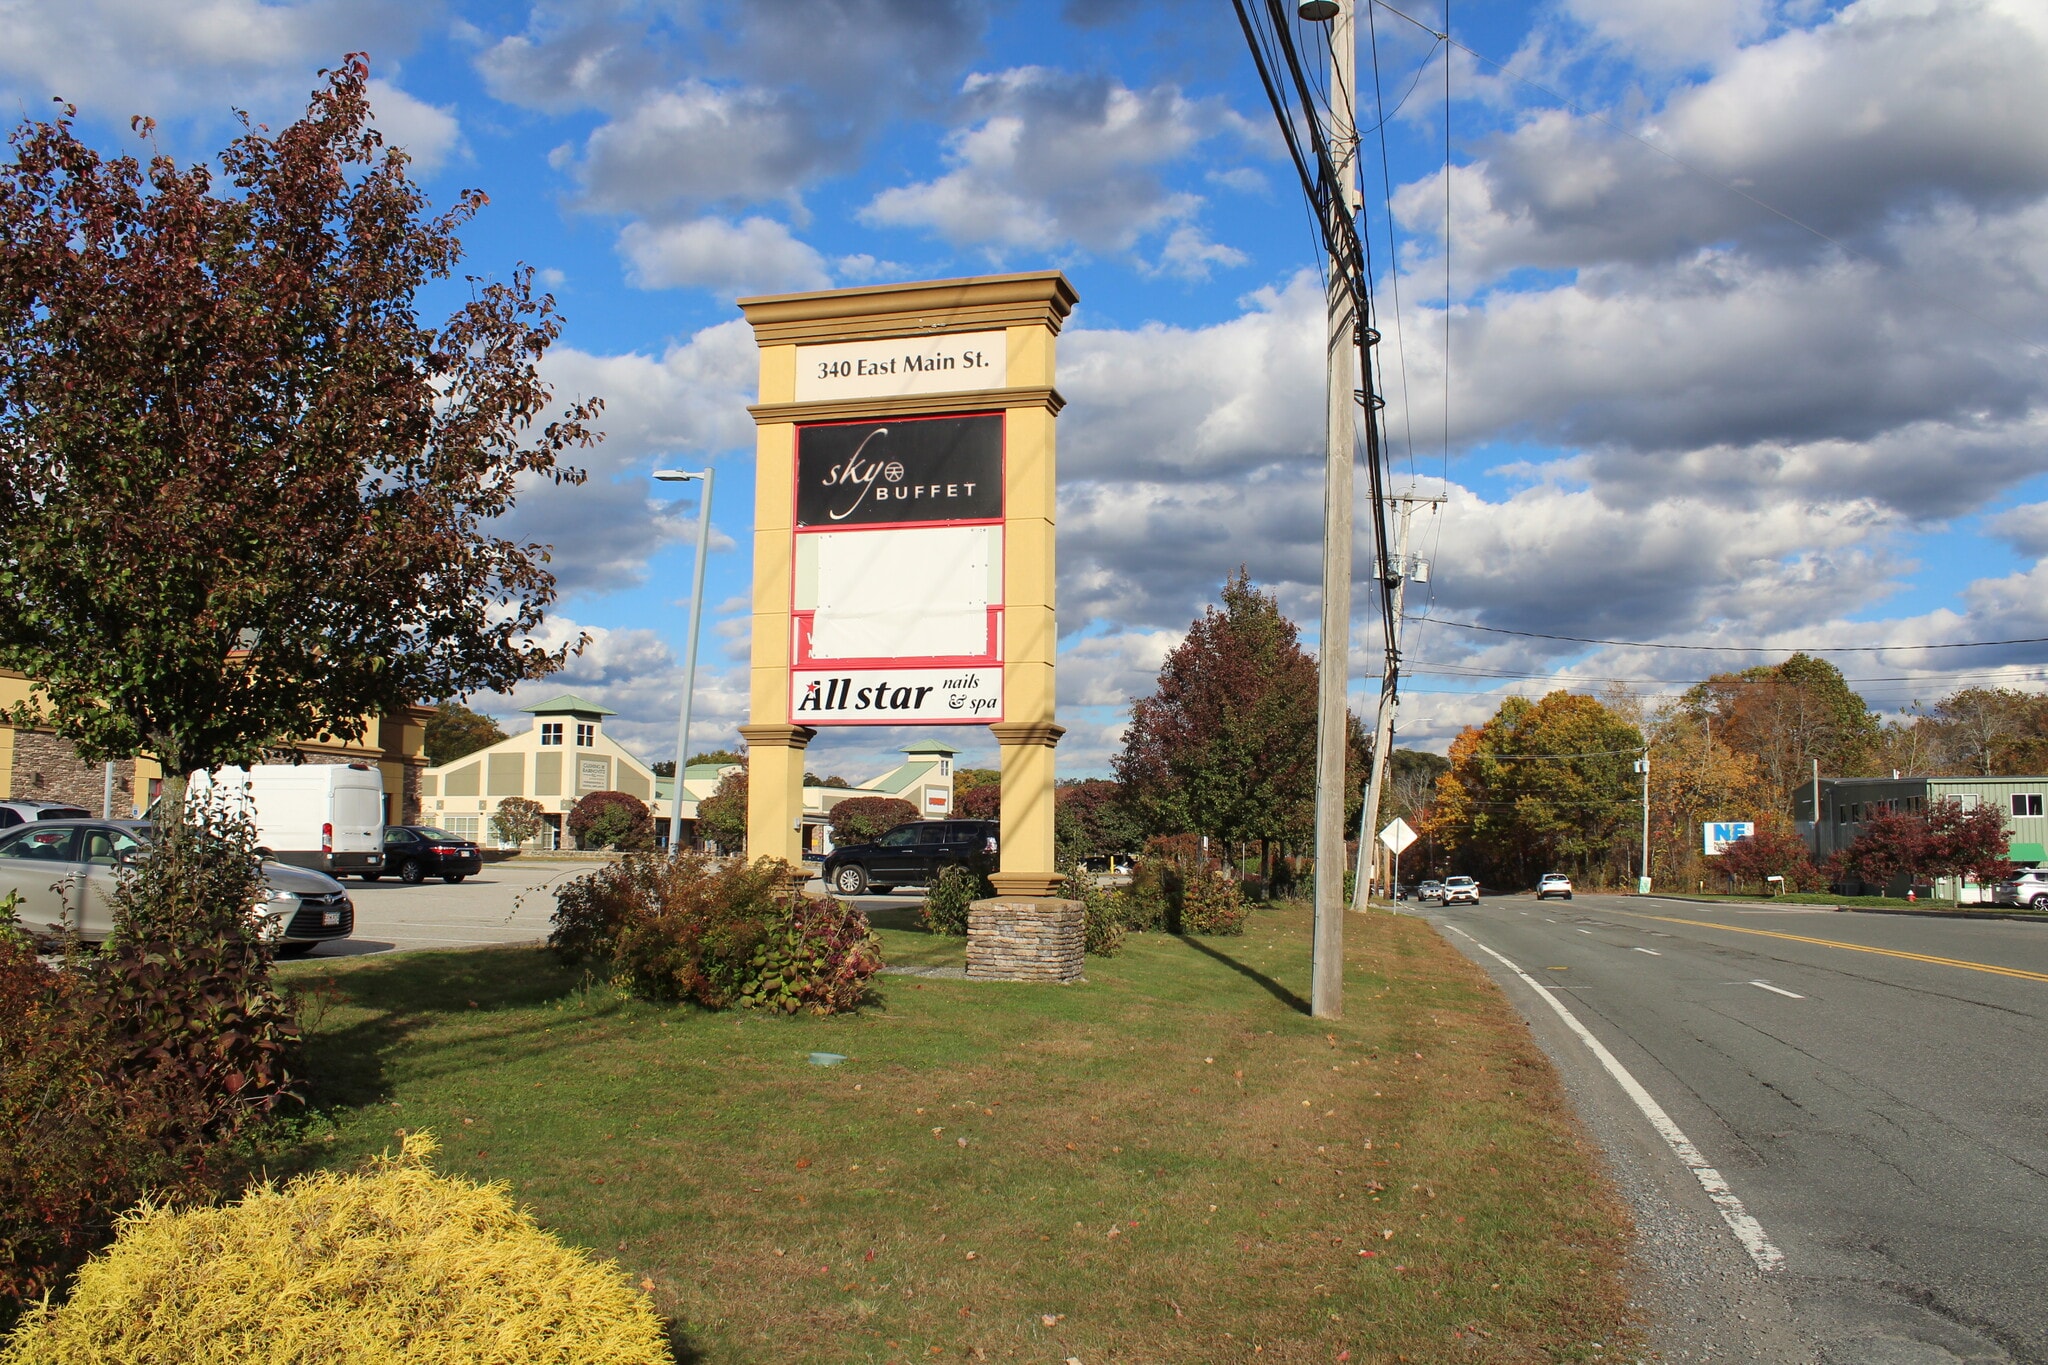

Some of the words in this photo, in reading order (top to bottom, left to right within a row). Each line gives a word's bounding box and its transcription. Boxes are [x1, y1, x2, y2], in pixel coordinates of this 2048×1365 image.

[818, 361, 851, 380] 340
[857, 359, 896, 377] East
[903, 353, 955, 373] Main
[962, 351, 990, 369] St.
[822, 427, 889, 520] sky
[876, 482, 977, 501] BUFFET
[942, 673, 980, 690] nails
[948, 694, 969, 710] &
[969, 697, 998, 715] spa
